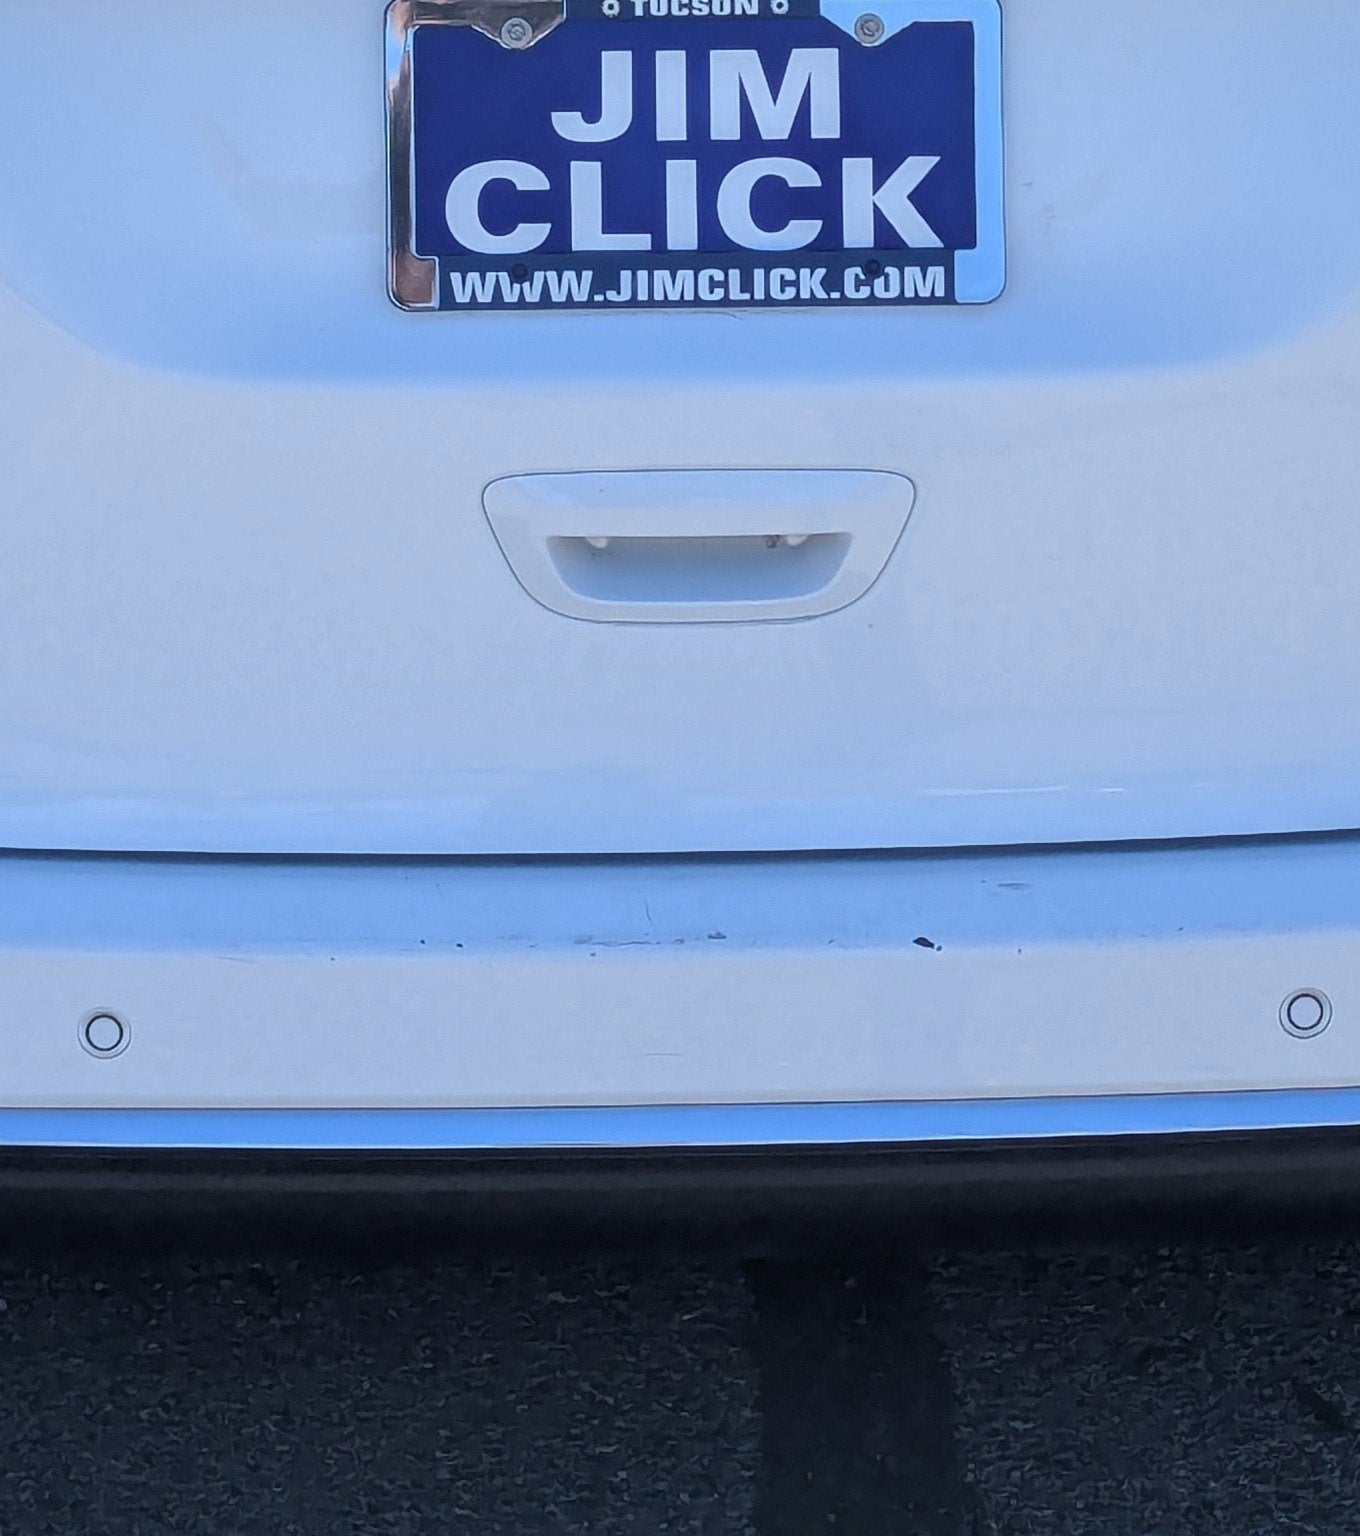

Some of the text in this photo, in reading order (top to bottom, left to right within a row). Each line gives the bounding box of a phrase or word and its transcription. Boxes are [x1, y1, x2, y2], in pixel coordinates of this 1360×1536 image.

[551, 48, 841, 142] JIM
[444, 156, 945, 254] CLICK
[450, 267, 946, 303] WWW.JIMCLICK.COM
